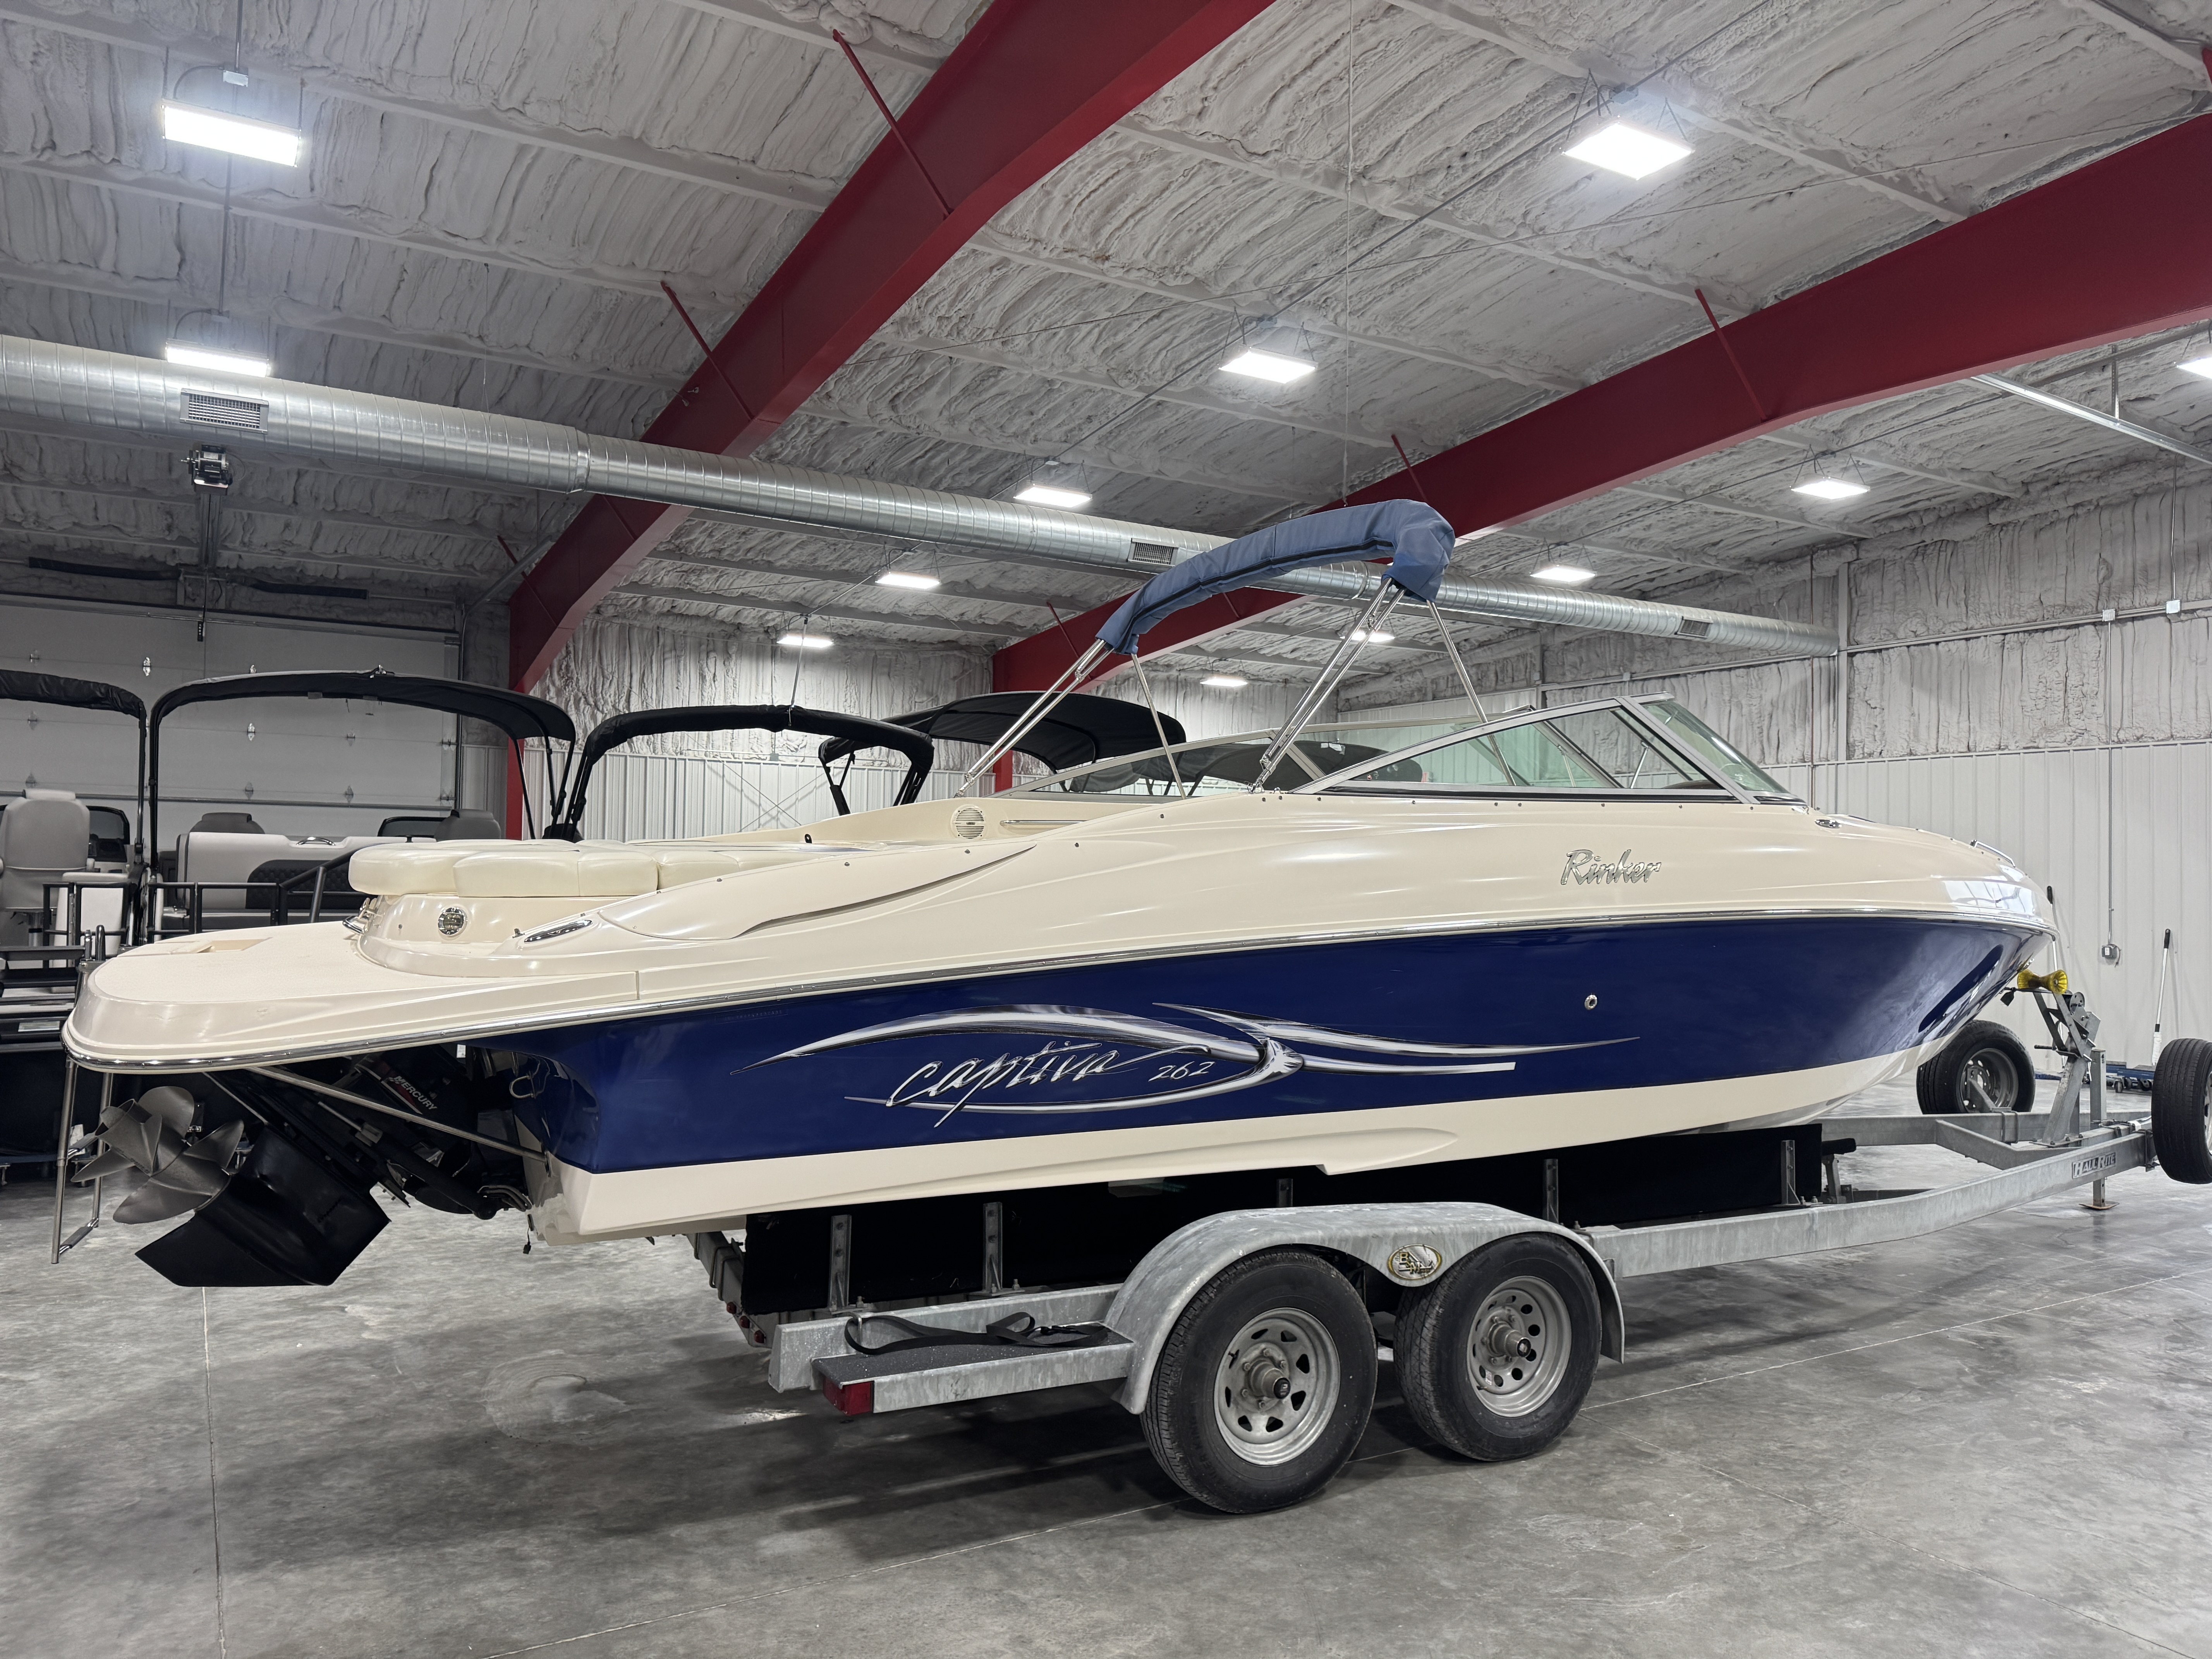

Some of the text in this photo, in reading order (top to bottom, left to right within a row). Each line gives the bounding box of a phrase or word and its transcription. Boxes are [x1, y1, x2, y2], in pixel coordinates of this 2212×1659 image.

[1560, 849, 1662, 885] Rinker
[1148, 1061, 1216, 1082] 262
[390, 1075, 438, 1110] MERCURY
